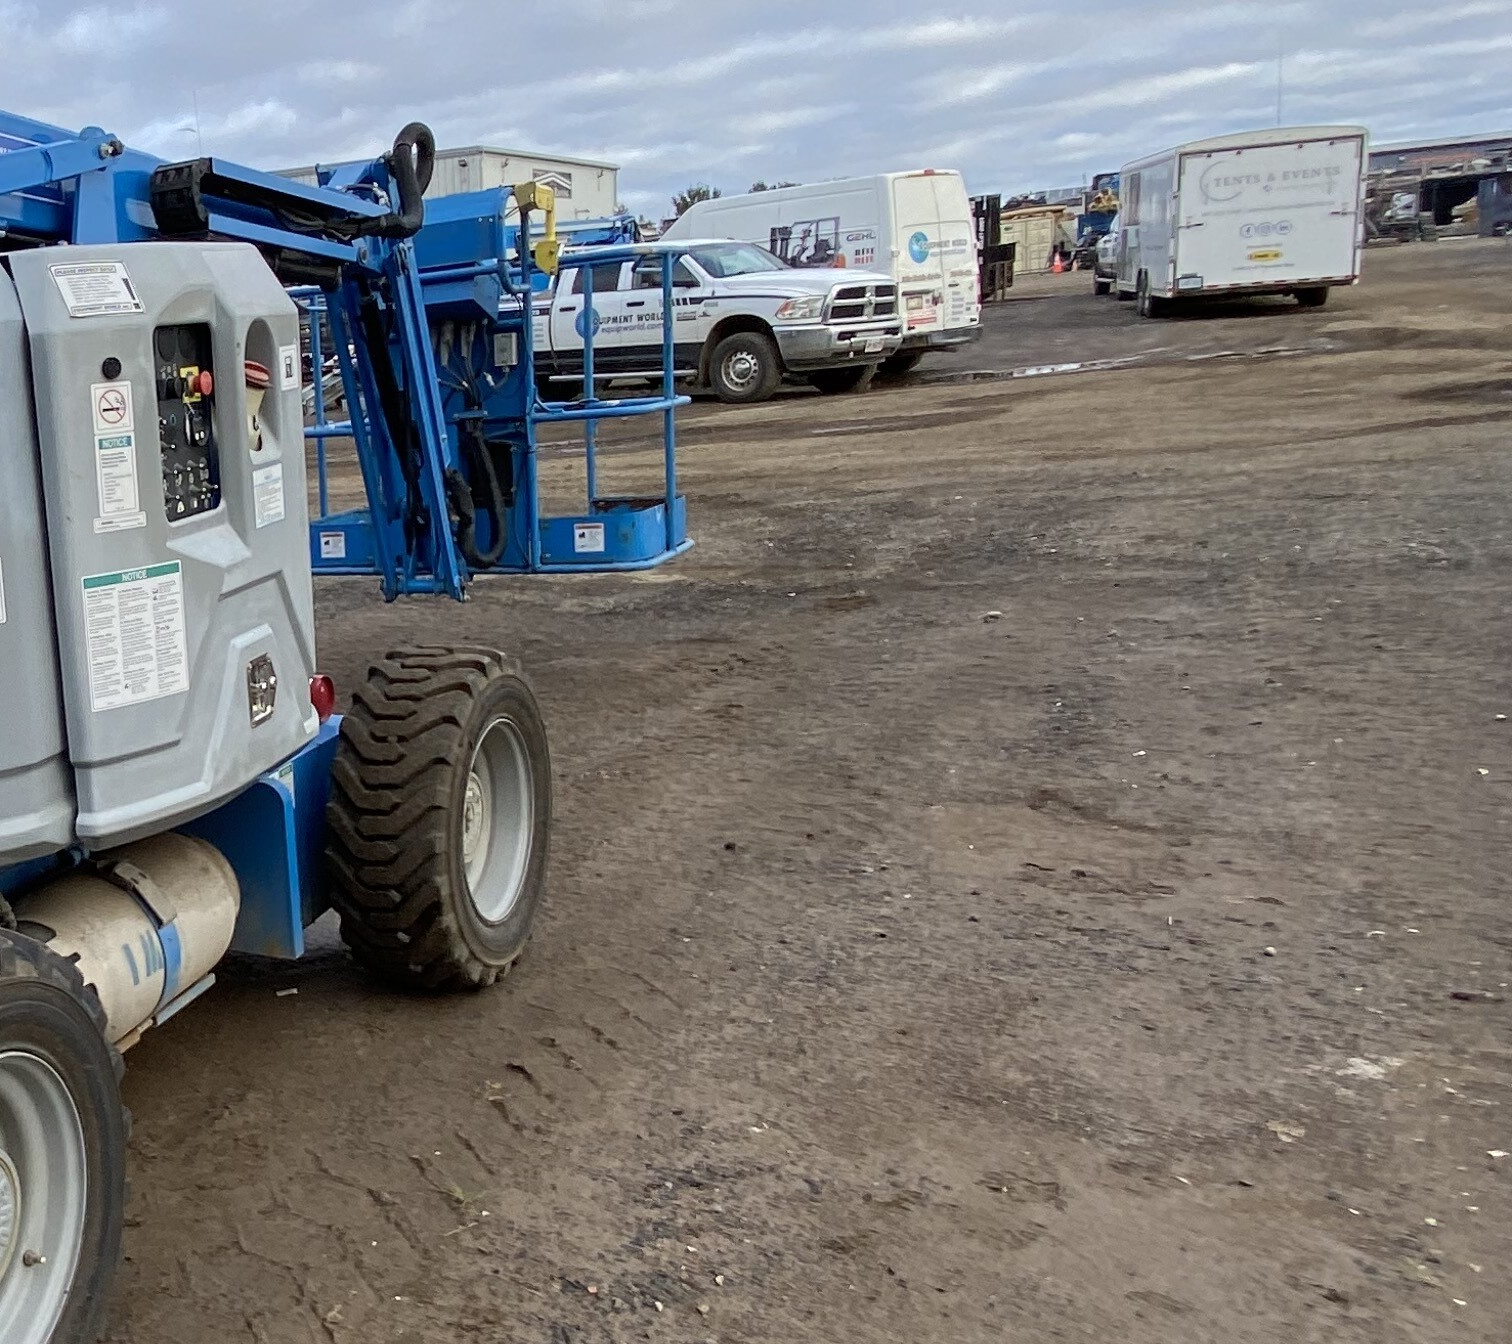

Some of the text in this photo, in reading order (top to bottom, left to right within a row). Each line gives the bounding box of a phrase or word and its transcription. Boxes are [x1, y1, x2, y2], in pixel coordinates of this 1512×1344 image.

[1214, 174, 1260, 187] TENTS
[1267, 172, 1276, 182] &
[1282, 165, 1340, 180] EVENTS
[846, 233, 876, 242] GEHL
[593, 314, 633, 325] QUIPMENT
[102, 437, 129, 448] NOTICE
[121, 569, 148, 582] NOTICE
